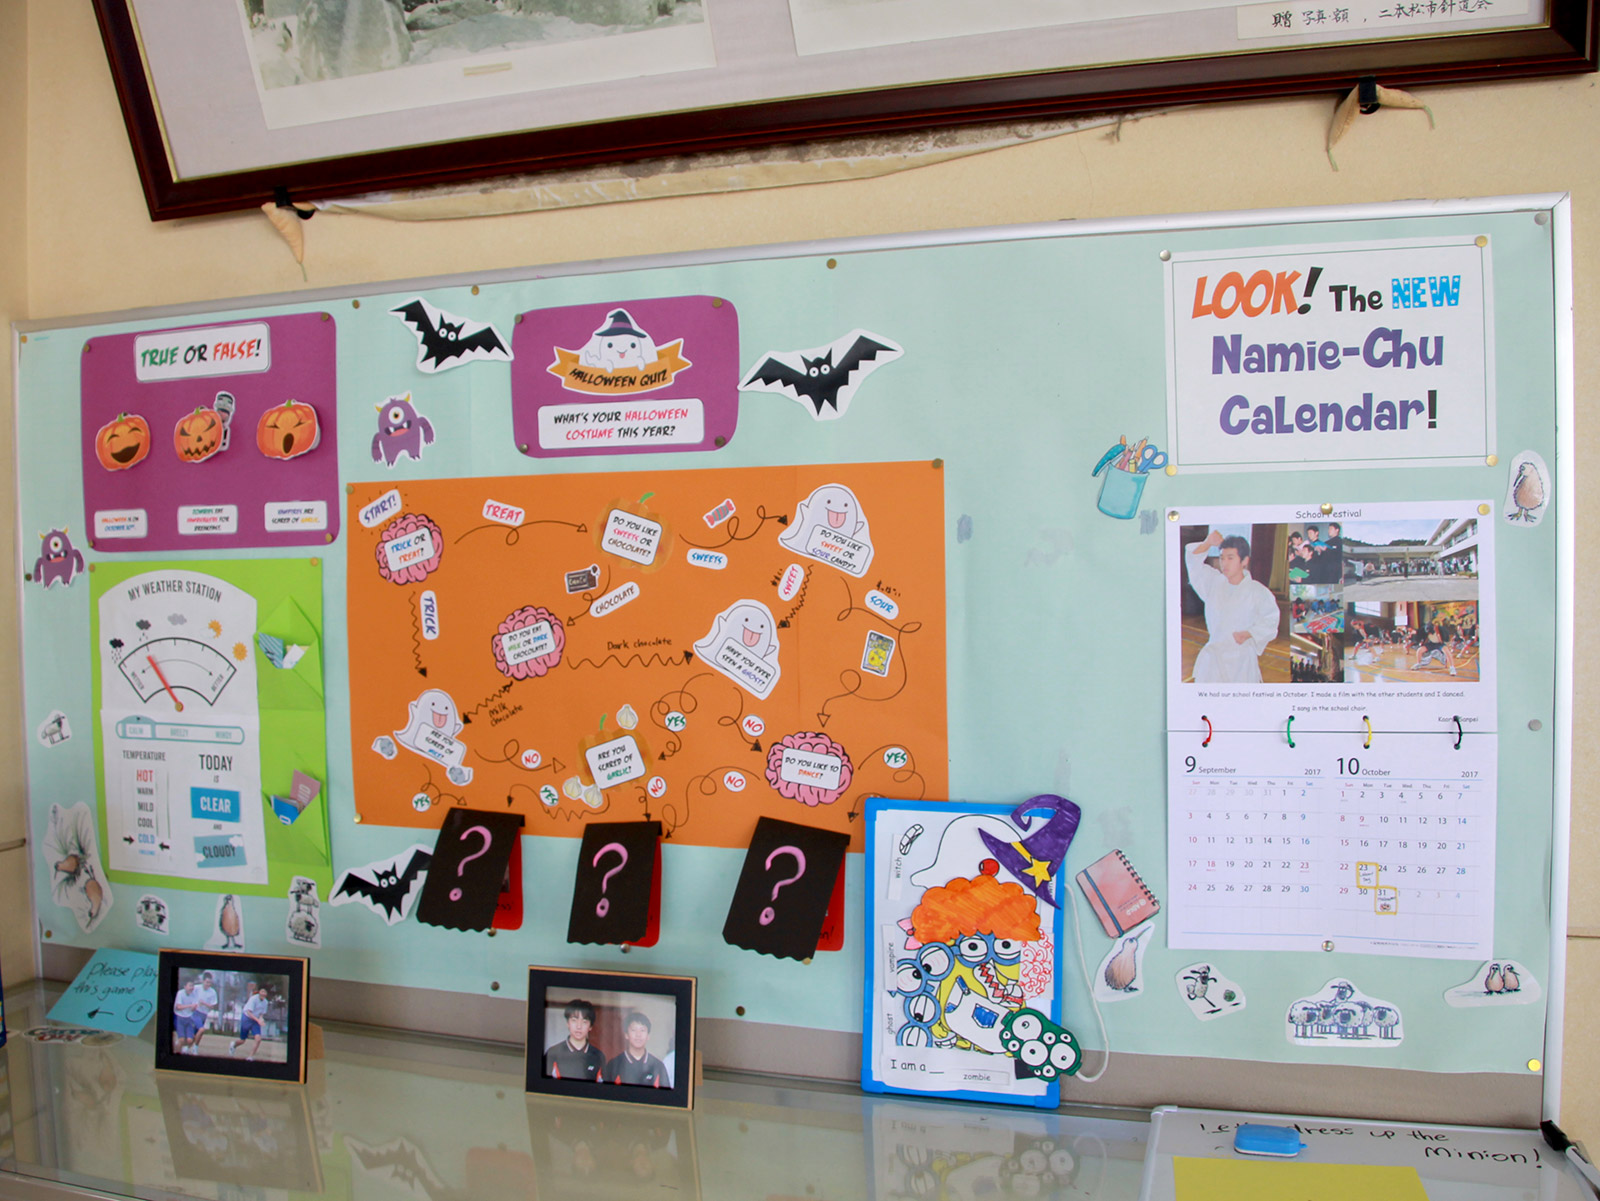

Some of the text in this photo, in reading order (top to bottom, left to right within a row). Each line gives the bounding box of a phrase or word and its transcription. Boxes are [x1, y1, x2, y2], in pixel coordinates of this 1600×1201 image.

[1191, 266, 1461, 319] LOOK! The NEW
[141, 338, 261, 367] TRUE OR FALSE!
[1211, 327, 1445, 375] Namie-Chu
[569, 368, 668, 388] HALLOWEEN QUIZ
[554, 408, 688, 424] WHAT'S YOUR HALLOWEEN
[566, 425, 676, 441] COSTUME THIS YEAR?
[364, 494, 397, 524] START!
[486, 504, 523, 523] TREAT
[613, 516, 658, 537] DO YOU LIKE
[391, 533, 426, 554] TRICK OR
[613, 528, 652, 547] SWEETS OR
[820, 529, 863, 552] DO YOU LIKE
[607, 538, 651, 558] CHOCOLATE?
[820, 541, 855, 560] SWEET OR
[691, 552, 724, 564] SWEETS
[811, 547, 856, 571] SOUR CANDY?
[783, 566, 799, 596] SWEET
[128, 580, 222, 602] MY WEATHER STATION
[595, 585, 635, 615] CHOCOLATE
[870, 595, 894, 614] SOUR
[424, 597, 437, 635] TRICK
[667, 715, 686, 727] YES
[744, 719, 763, 733] NO
[122, 750, 166, 761] TEMPERATURE
[524, 753, 540, 765] NO
[598, 745, 626, 760] ARE YOU
[886, 752, 907, 764] YES
[199, 754, 233, 771] TODAY
[598, 753, 633, 771] SCARED OF
[785, 756, 796, 765] DO
[797, 759, 812, 768] YOU
[812, 762, 829, 771] LIKE
[1185, 755, 1321, 776] 9 September 2017
[1336, 757, 1478, 779] 10 October 2017
[136, 770, 153, 782] HOT
[213, 775, 219, 783] IS
[726, 776, 744, 788] NO
[137, 788, 154, 796] WARM
[541, 787, 558, 804] YES
[650, 778, 664, 795] NO
[138, 802, 154, 812] MILD
[199, 796, 232, 814] CLEAR
[413, 795, 430, 808] YES
[137, 818, 154, 828] COOL
[138, 834, 155, 844] COLD
[1399, 841, 1408, 849] 18
[1418, 841, 1427, 849] 19
[1437, 842, 1447, 850] 20
[1456, 842, 1465, 850] 21
[203, 845, 236, 859] CLOUDY
[449, 825, 493, 902] ?
[894, 857, 903, 878] witch
[1378, 864, 1387, 872] 24
[1397, 865, 1407, 873] 25
[1417, 866, 1427, 874] 26
[1456, 867, 1466, 875] 28
[592, 842, 629, 918] ?
[759, 845, 806, 926] ?
[888, 941, 896, 973] vampire
[87, 962, 130, 980] Please
[72, 980, 136, 1002] this game
[886, 1012, 895, 1035] ghost
[891, 1059, 926, 1071] I am a
[963, 1073, 991, 1081] zombie
[1370, 1130, 1396, 1140] up
[1408, 1130, 1449, 1142] the
